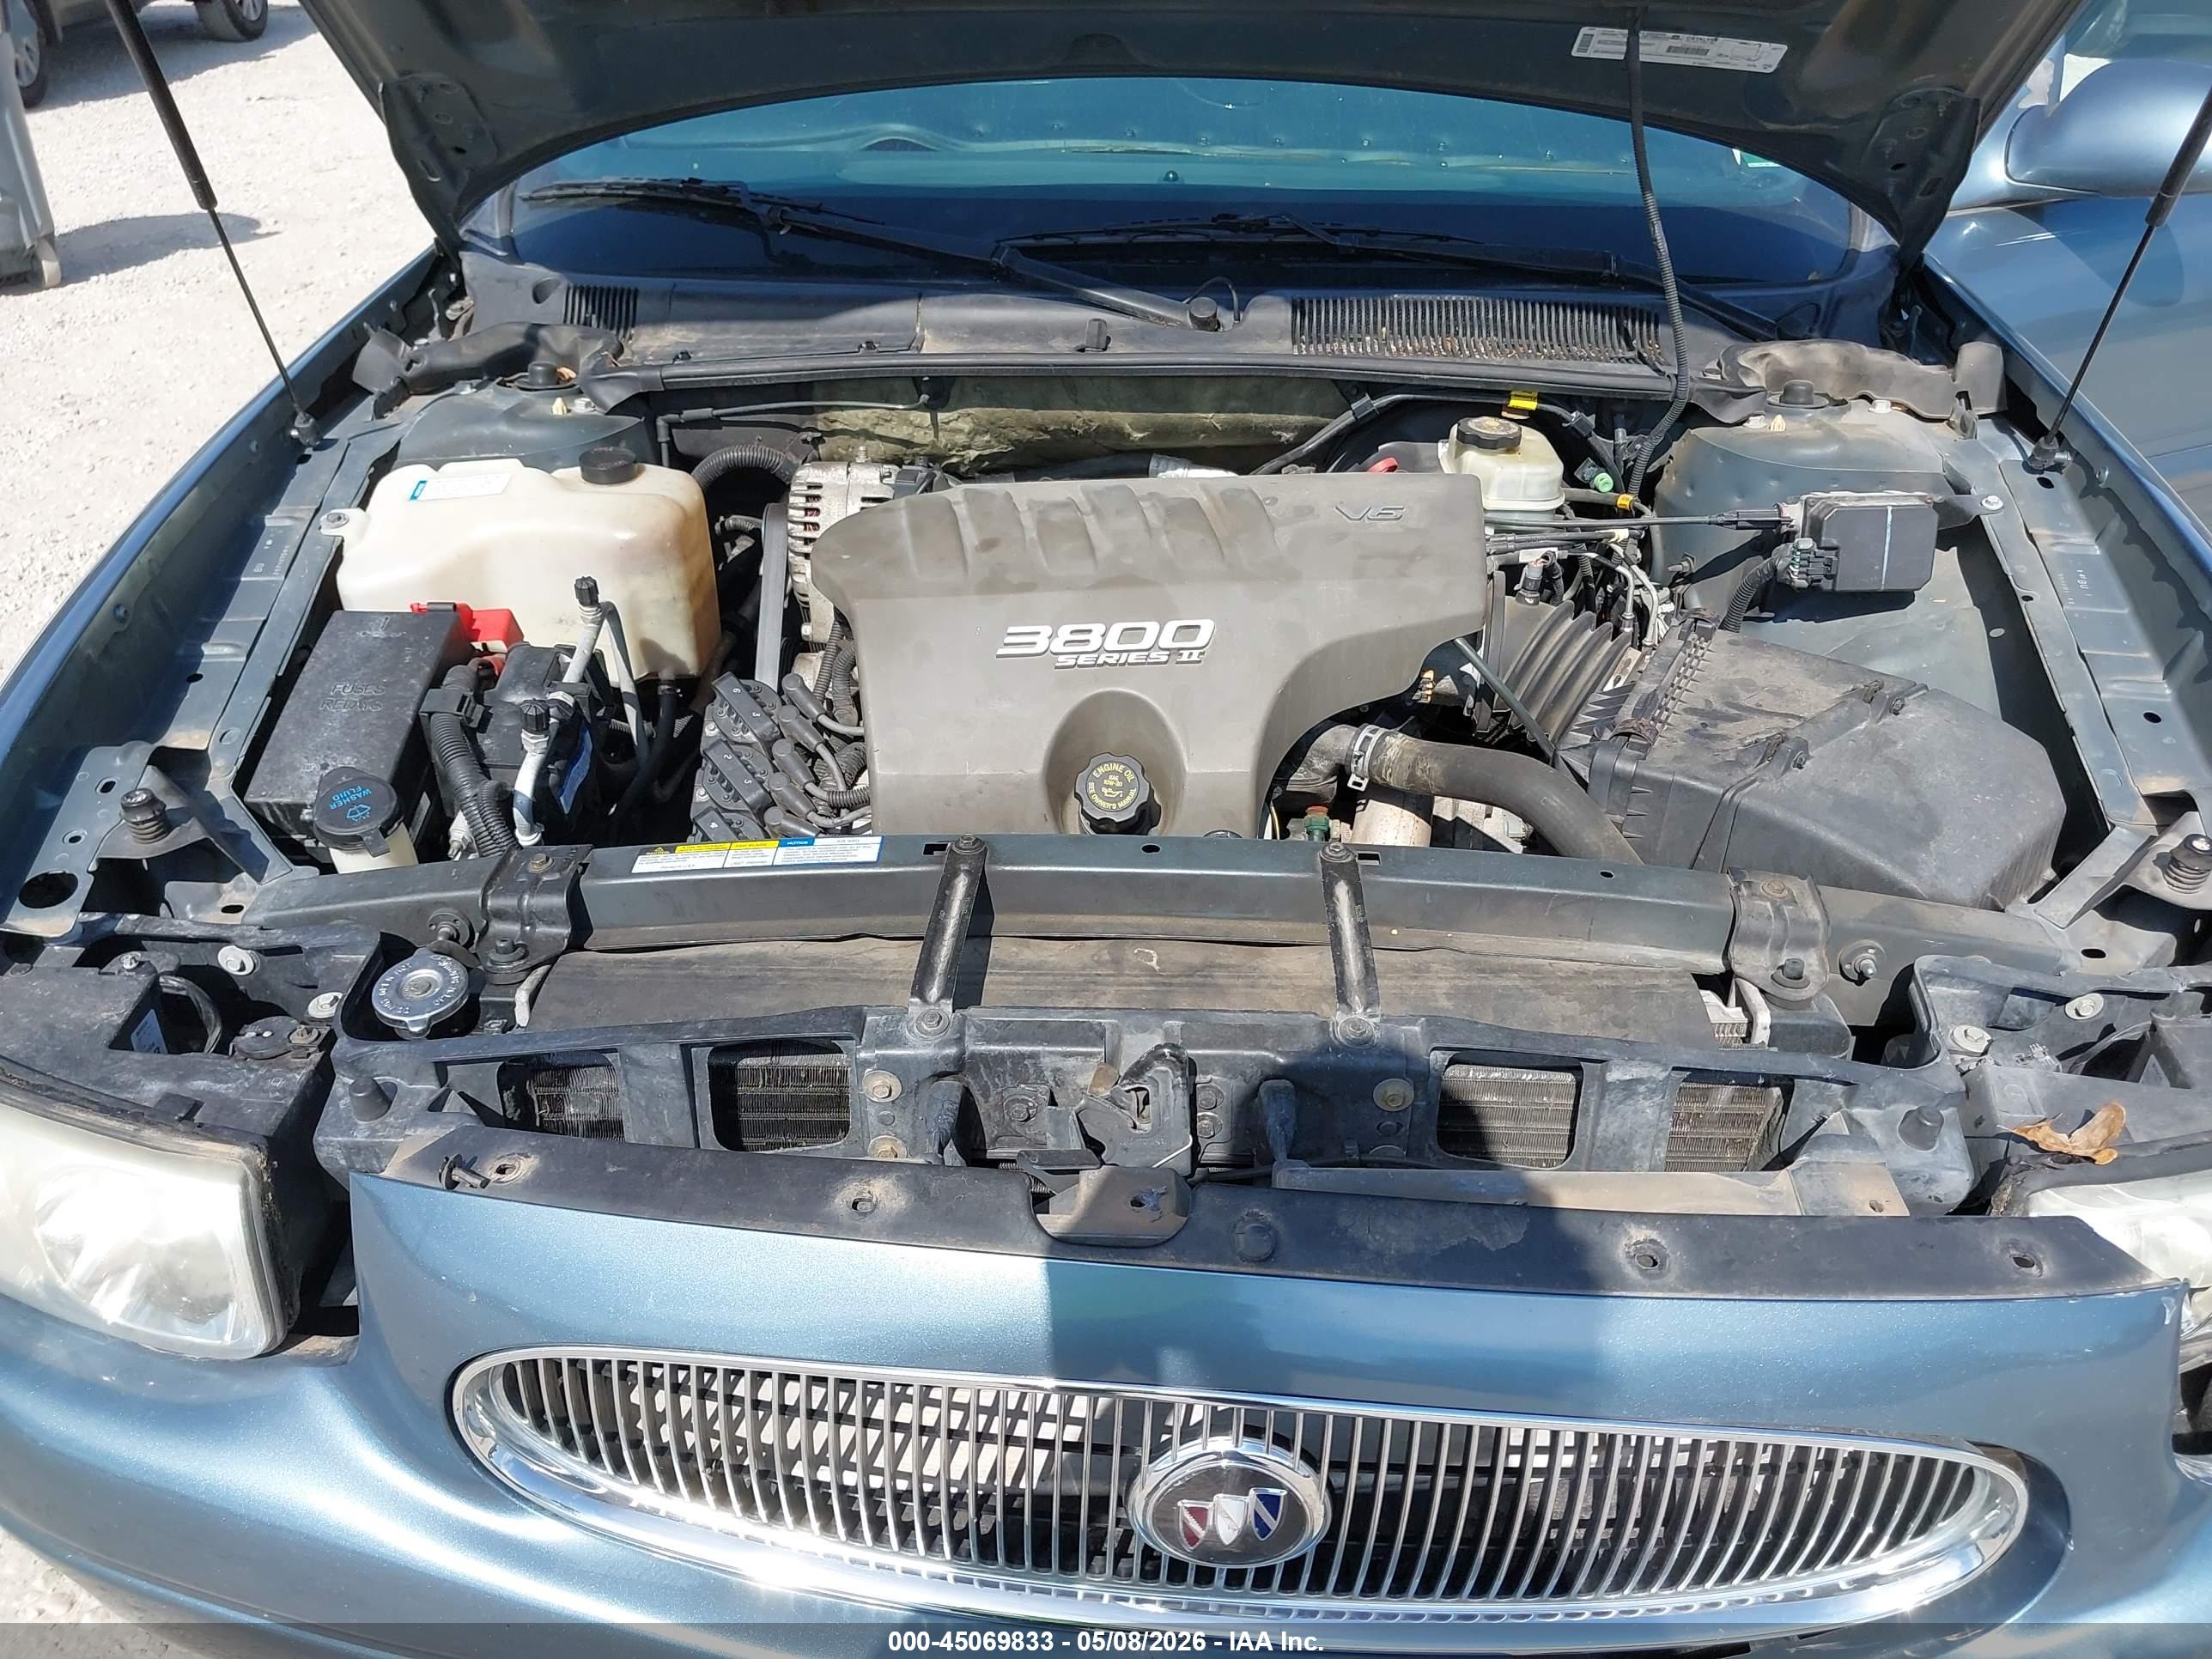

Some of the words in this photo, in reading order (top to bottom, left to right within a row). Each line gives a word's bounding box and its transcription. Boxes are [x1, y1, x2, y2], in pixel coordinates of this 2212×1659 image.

[1334, 505, 1405, 522] V6
[995, 618, 1216, 659] 3800
[1054, 651, 1170, 670] SERIES
[1176, 650, 1206, 665] II
[330, 682, 386, 696] FUSES
[319, 697, 383, 712] RELAYS
[1093, 763, 1125, 777] ENGINE
[1124, 770, 1135, 782] OIL
[329, 788, 372, 810] WASHER
[331, 786, 362, 801] FLUID
[1091, 794, 1116, 810] OWNER'S
[1117, 787, 1136, 808] MANUAL
